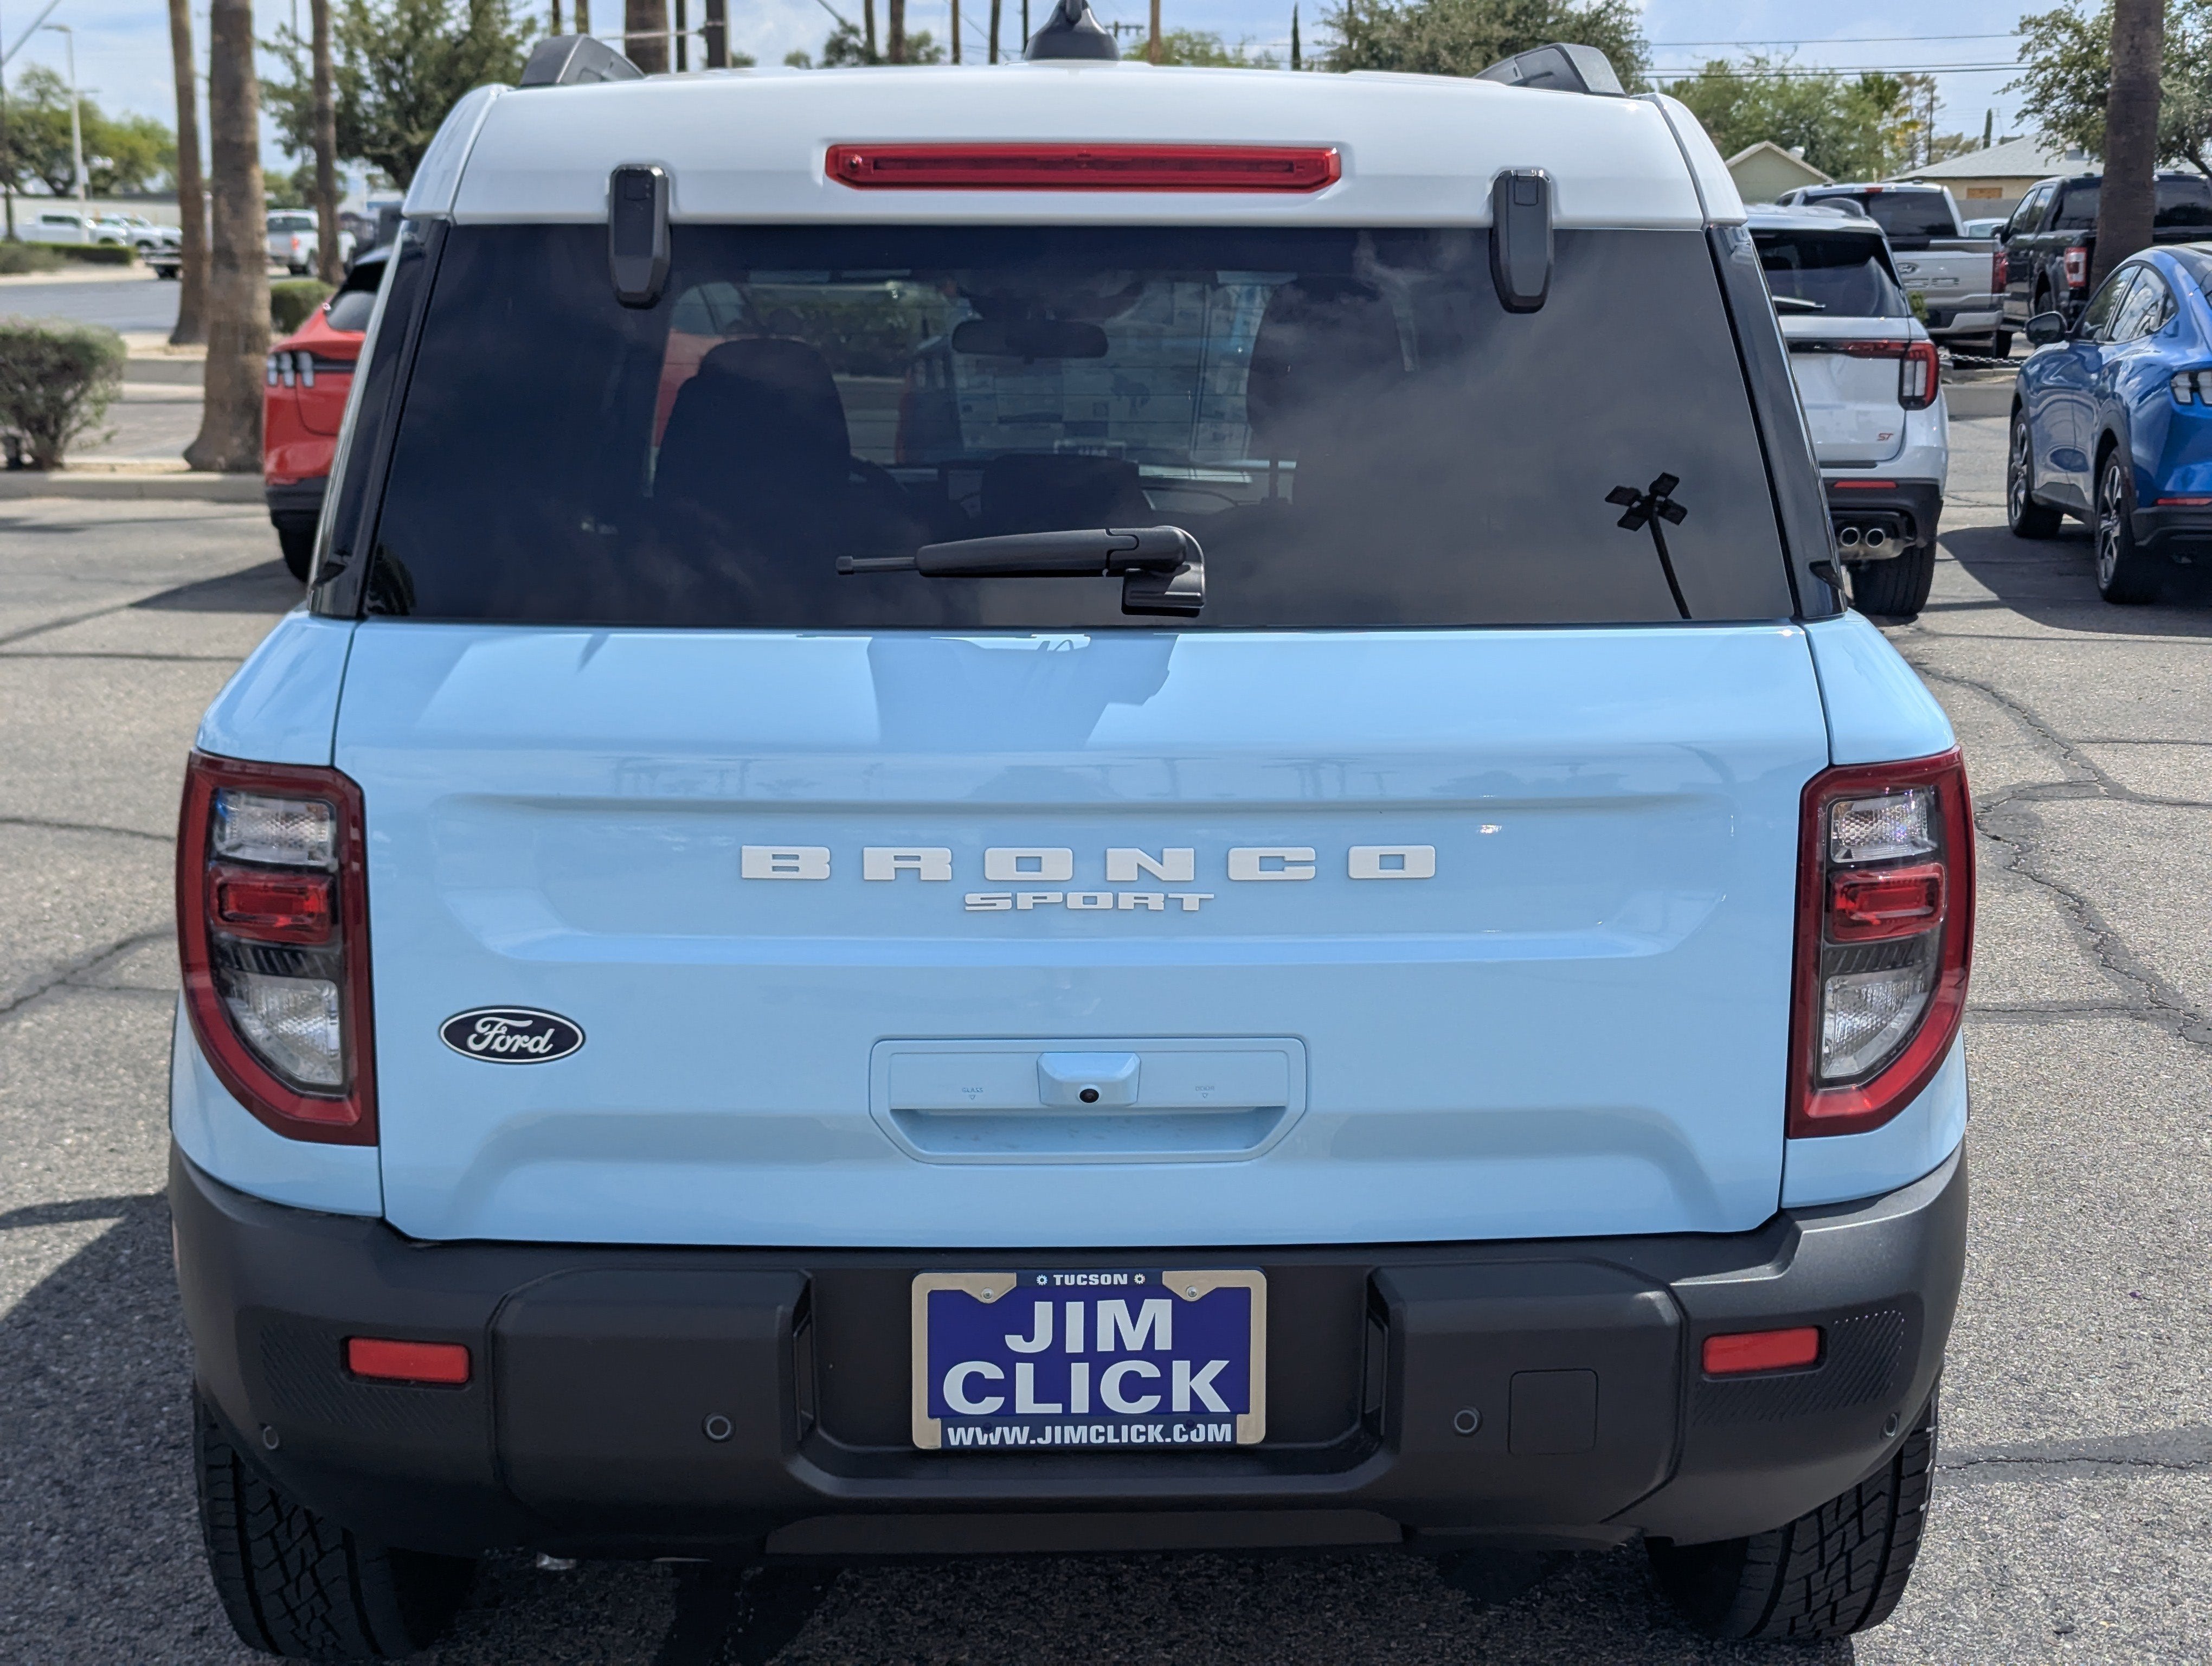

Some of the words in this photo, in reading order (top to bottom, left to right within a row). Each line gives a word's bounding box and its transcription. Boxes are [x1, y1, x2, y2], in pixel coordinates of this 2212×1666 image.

[1877, 432, 1894, 441] ST
[741, 844, 1436, 881] BRONCO
[965, 891, 1215, 911] SPORT
[466, 1016, 555, 1054] Ford
[1053, 1273, 1128, 1286] TUCSON
[1005, 1298, 1173, 1354] JIM
[942, 1359, 1231, 1415] CLICK
[947, 1423, 1232, 1446] WWW.JIMCLICK.COM
